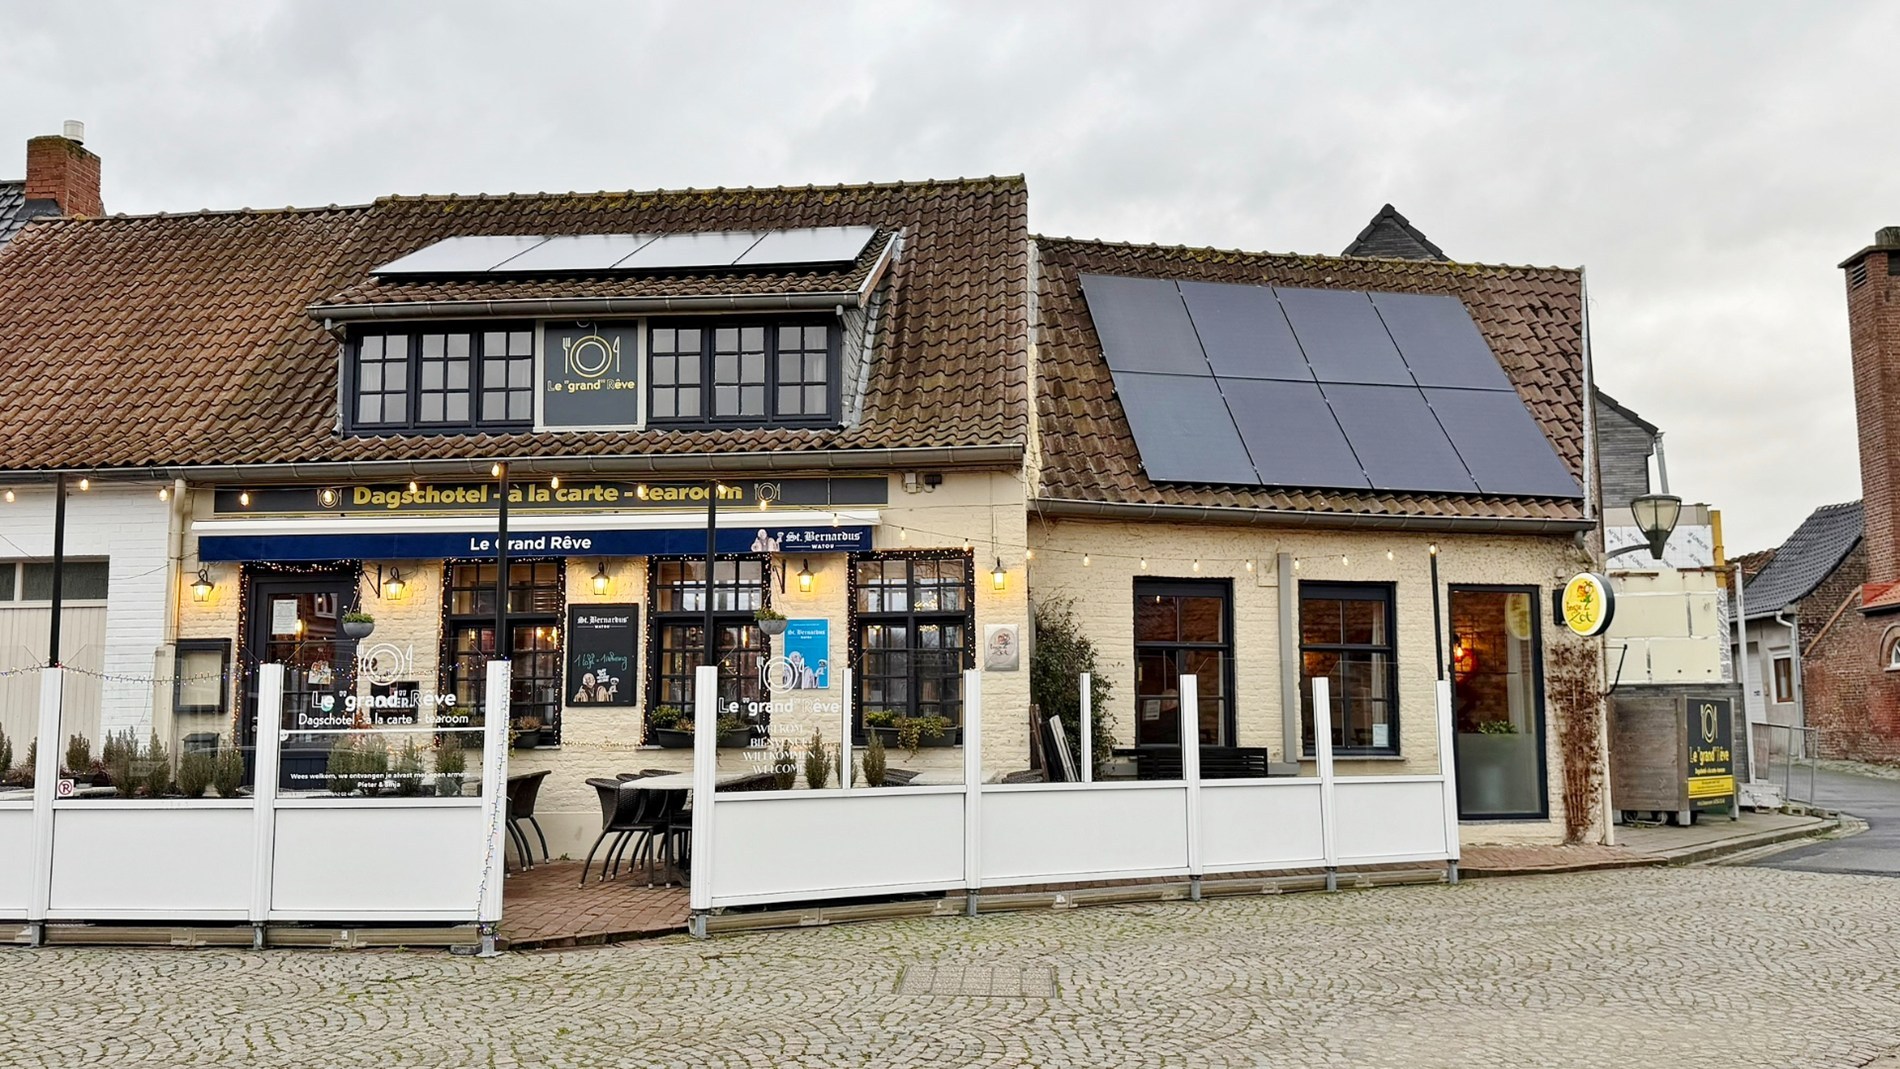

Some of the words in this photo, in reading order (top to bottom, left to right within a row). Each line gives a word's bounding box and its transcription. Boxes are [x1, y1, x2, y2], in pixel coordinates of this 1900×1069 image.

[547, 380, 562, 392] Le
[606, 378, 636, 390] Rêve
[353, 484, 488, 509] Dagschotel
[508, 484, 523, 503] à
[529, 484, 550, 502] la
[555, 484, 619, 502] carte
[643, 484, 743, 501] tearoom
[470, 537, 490, 550] Le
[550, 535, 592, 550] Rêve
[785, 531, 803, 543] St.
[804, 531, 862, 543] Bernardus
[589, 616, 629, 625] Bernardus
[312, 690, 335, 709] Le
[410, 689, 457, 709] Rêve
[718, 697, 739, 714] Le
[801, 698, 840, 713] Rêve
[298, 713, 355, 729] Dagschotel
[374, 713, 384, 725] la
[386, 713, 413, 726] carte
[425, 713, 469, 725] tearoom
[755, 724, 803, 734] WELKOM
[742, 750, 816, 762] WILLKOMMEN
[752, 763, 805, 775] WELCOME
[290, 772, 309, 781] Wees
[310, 772, 338, 782] welkom,
[349, 773, 385, 782] ontvangen
[385, 772, 392, 782] je
[393, 772, 413, 780] alvast
[357, 781, 378, 789] Pieter
